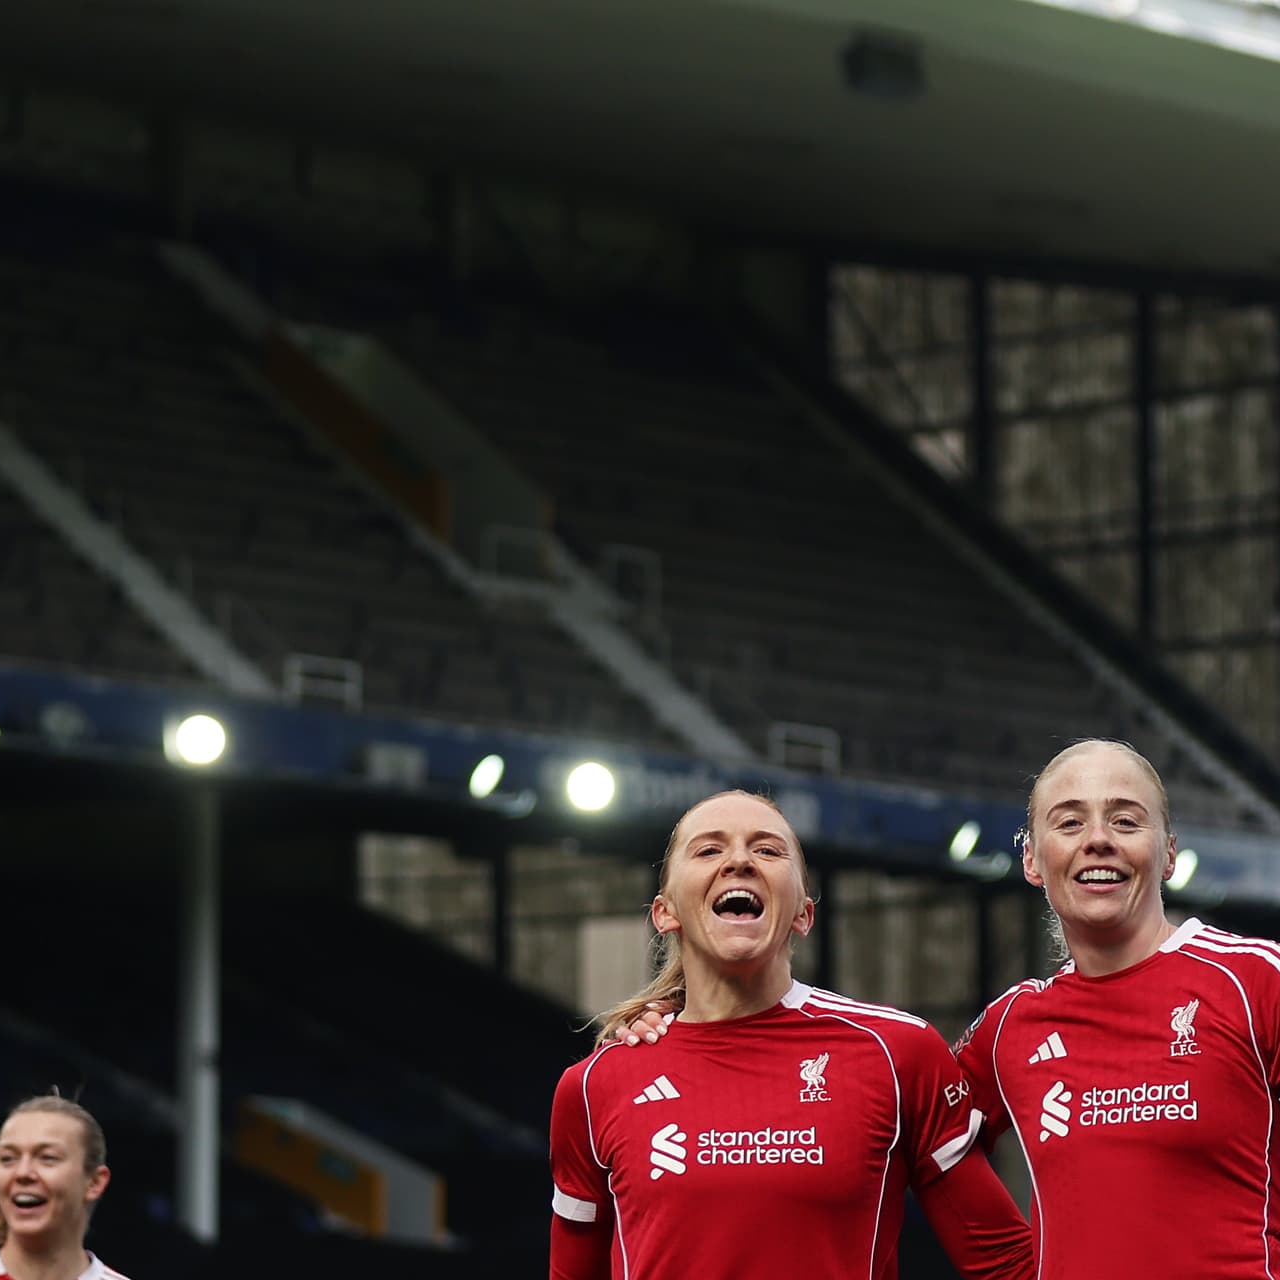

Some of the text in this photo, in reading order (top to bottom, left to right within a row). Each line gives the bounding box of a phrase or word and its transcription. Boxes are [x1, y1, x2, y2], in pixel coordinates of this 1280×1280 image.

[1081, 1080, 1190, 1107] standard
[1079, 1101, 1198, 1126] chartered
[697, 1127, 816, 1148] standard
[696, 1146, 824, 1166] chartered
